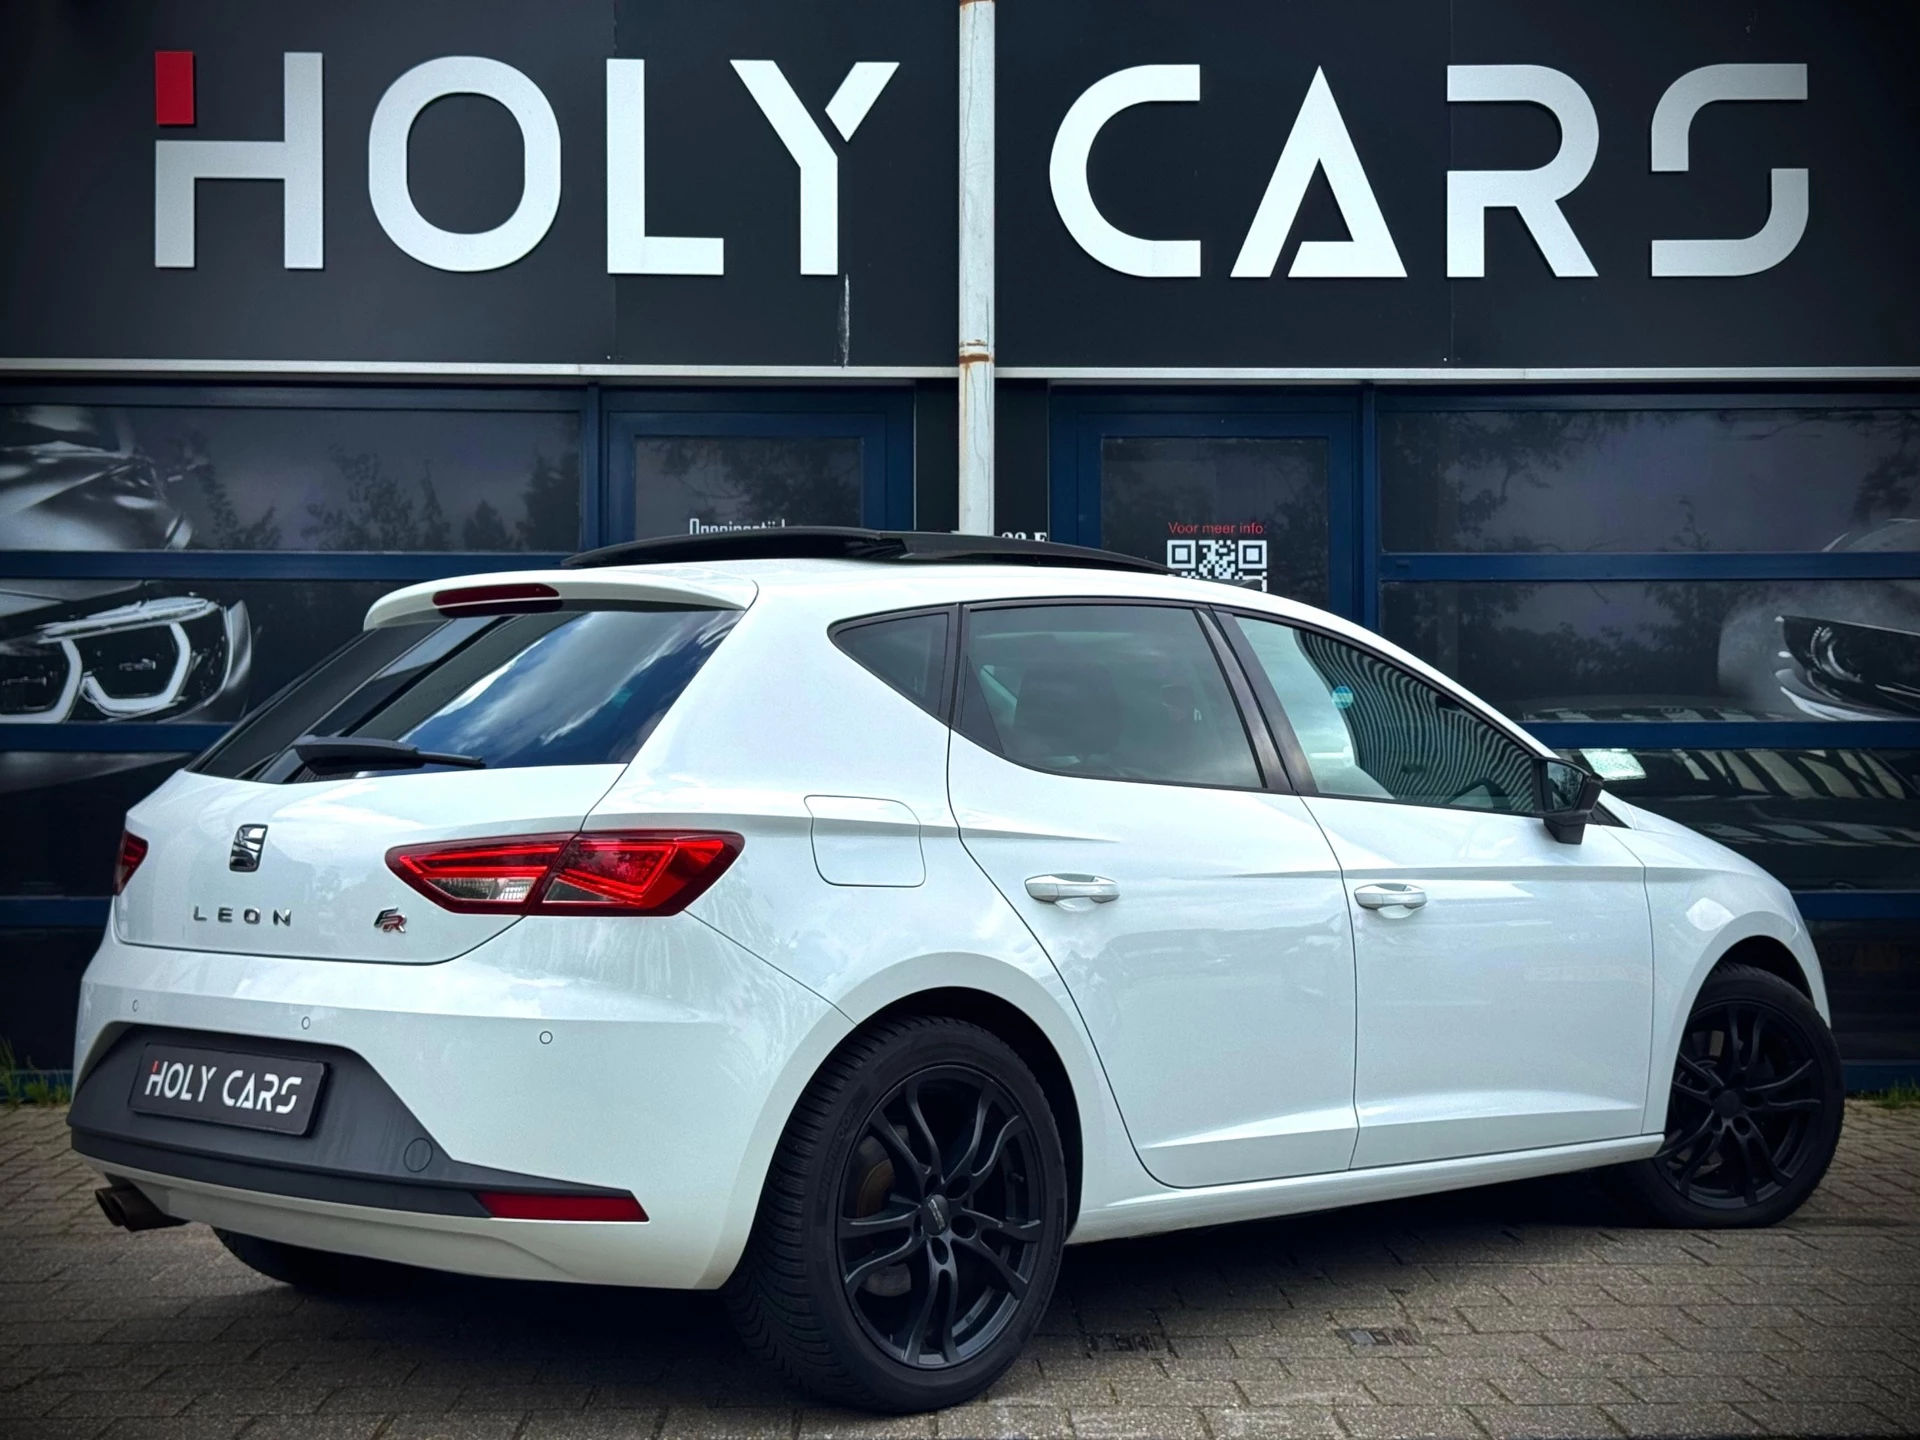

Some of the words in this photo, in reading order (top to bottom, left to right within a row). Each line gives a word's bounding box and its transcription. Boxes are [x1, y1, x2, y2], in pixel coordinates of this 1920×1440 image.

[154, 51, 900, 276] HOLY
[1049, 63, 1809, 278] CARS
[1168, 522, 1199, 535] Voor
[1202, 524, 1235, 535] meer
[1240, 522, 1267, 535] info:
[193, 906, 292, 926] LEON
[374, 907, 407, 933] FR
[145, 1060, 217, 1103] HOLY
[222, 1070, 302, 1114] CARS
